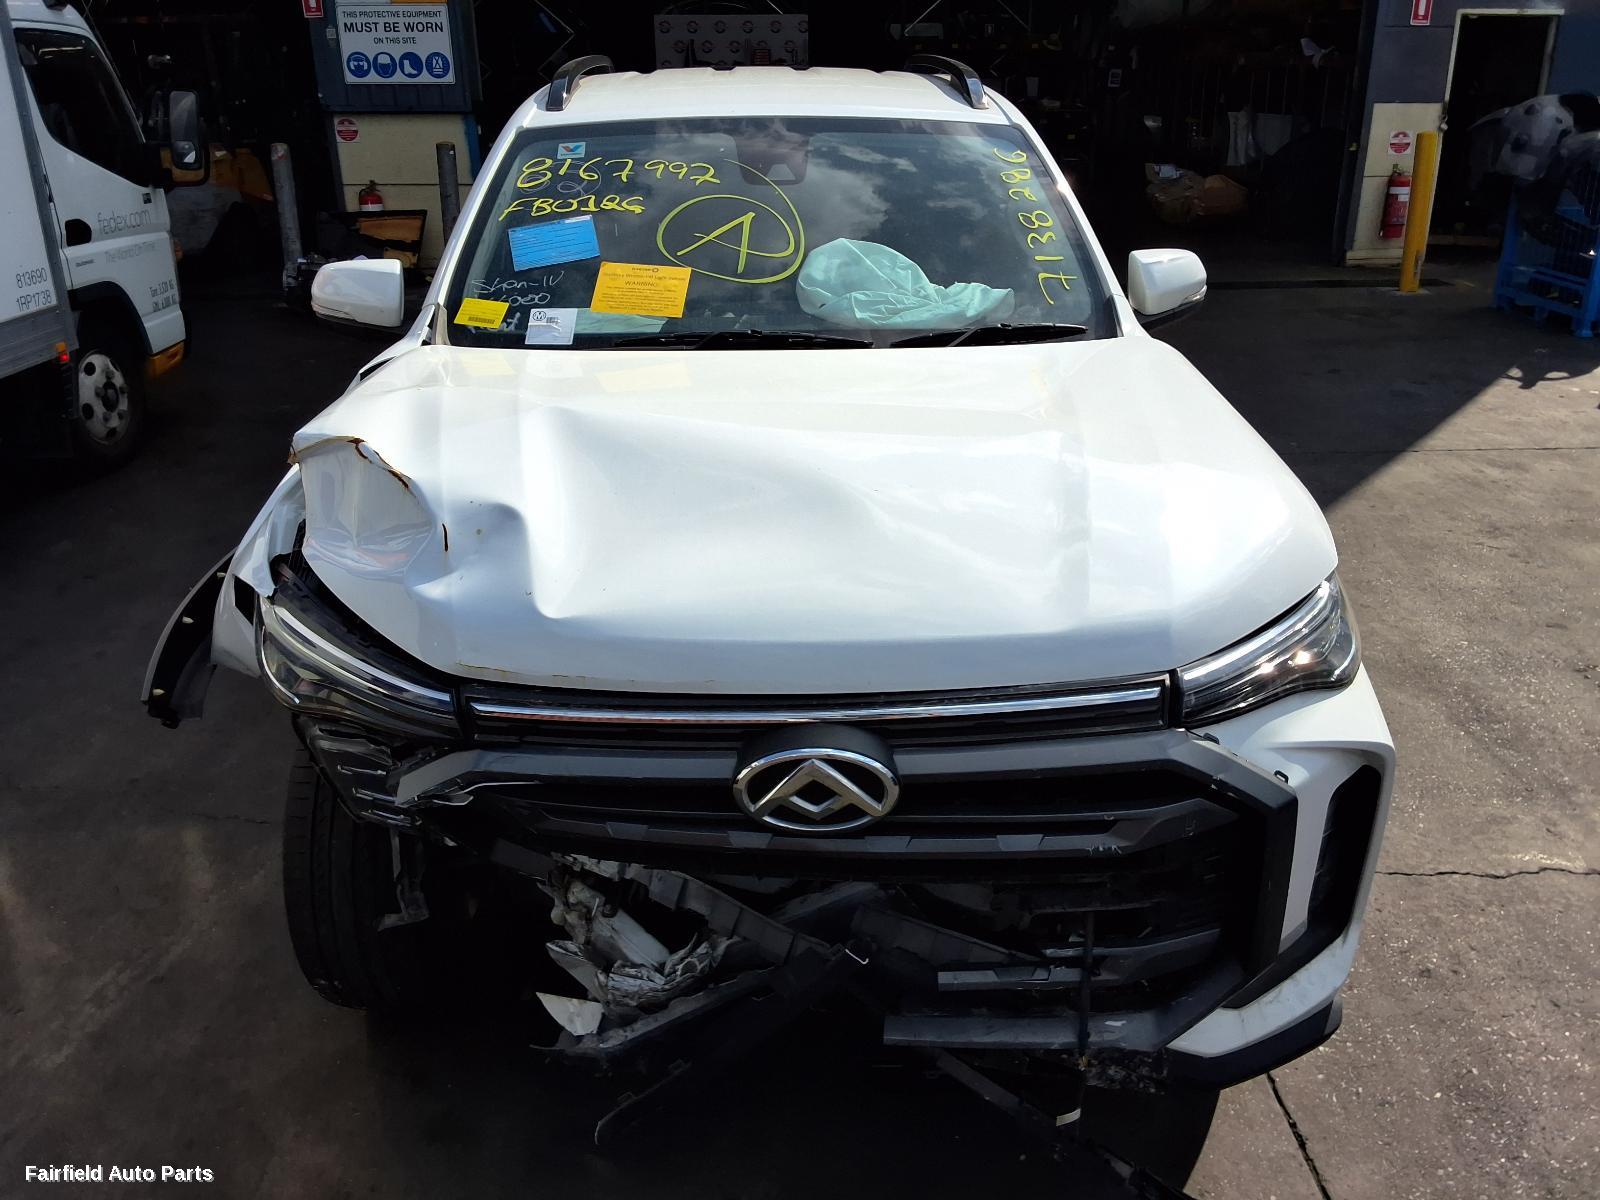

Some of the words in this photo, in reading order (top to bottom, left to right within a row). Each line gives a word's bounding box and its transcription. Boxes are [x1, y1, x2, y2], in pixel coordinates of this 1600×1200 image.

[343, 10, 358, 18] THIS
[359, 10, 400, 18] PROTECTIVE
[402, 10, 442, 18] EQUIPMENT
[343, 21, 379, 33] MUST
[383, 21, 401, 33] BE
[404, 21, 443, 33] WORN
[373, 36, 384, 44] ON
[386, 36, 401, 44] THIS
[402, 36, 417, 44] SITE
[97, 209, 152, 235] fedex.com
[675, 211, 756, 274] A
[16, 267, 48, 289] 813690
